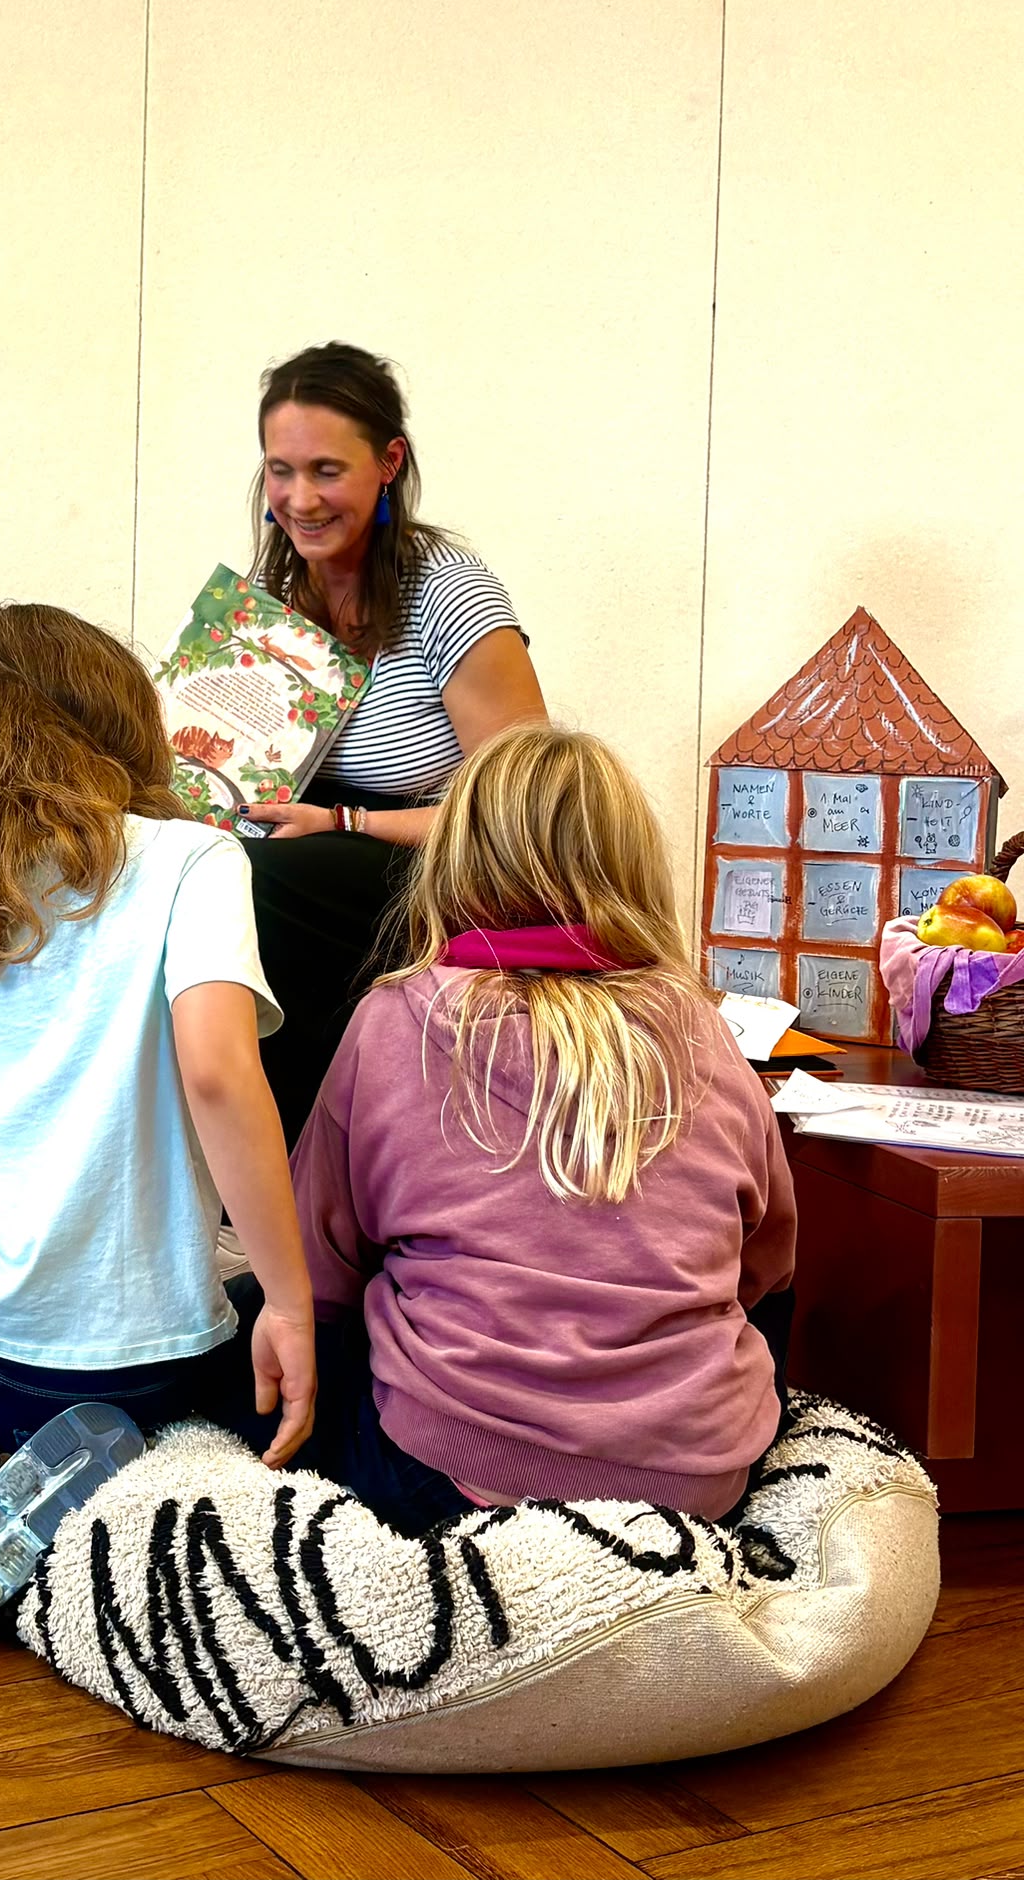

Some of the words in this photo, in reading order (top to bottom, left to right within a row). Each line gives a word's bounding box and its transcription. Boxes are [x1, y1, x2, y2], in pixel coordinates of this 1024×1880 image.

[732, 782, 775, 795] NAMEN
[832, 793, 852, 804] Mal
[732, 808, 772, 820] WORTE
[827, 807, 845, 815] am
[822, 817, 861, 833] MEER
[818, 881, 862, 897] ESSEN
[726, 967, 765, 982] MUSIK
[817, 969, 860, 983] EIGENE
[815, 982, 864, 1003] KINDER
